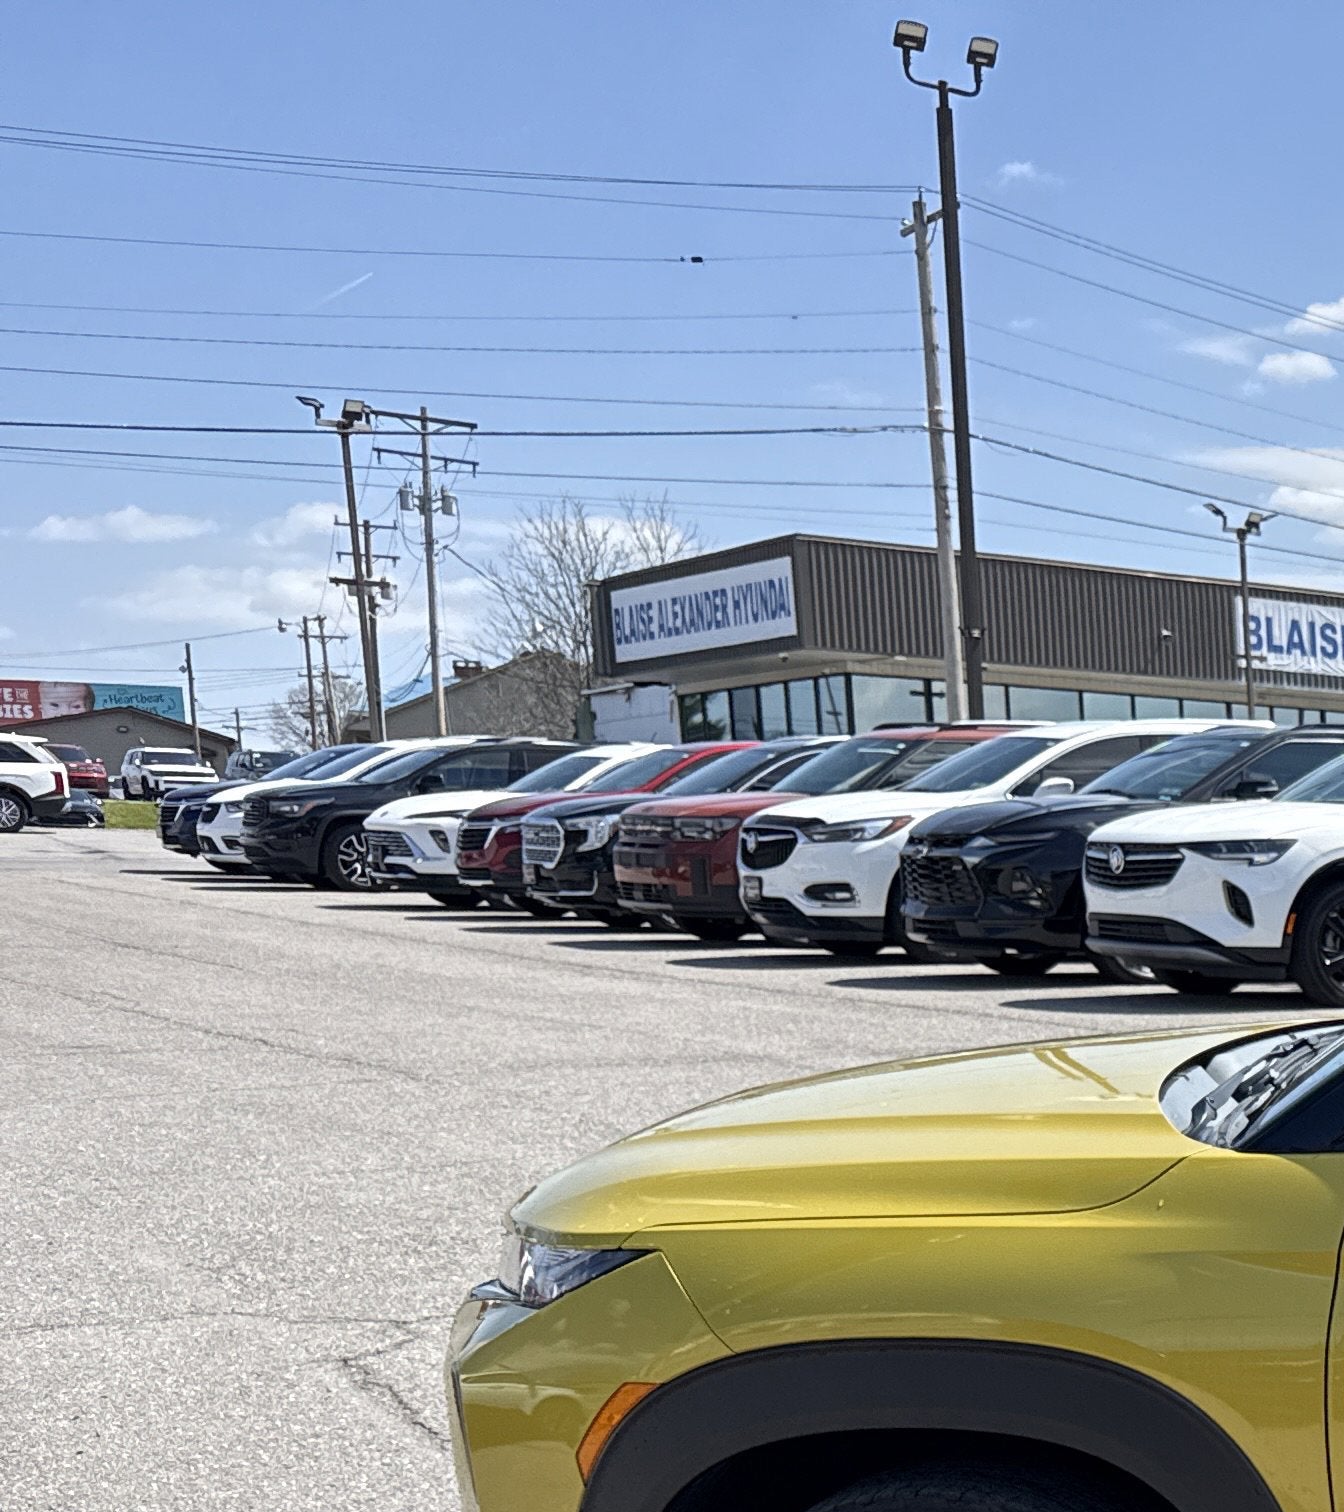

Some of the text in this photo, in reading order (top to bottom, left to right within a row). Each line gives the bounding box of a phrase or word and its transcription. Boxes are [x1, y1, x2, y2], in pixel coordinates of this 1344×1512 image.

[614, 577, 792, 645] BLAISE ALEXANDER HYUNDAI
